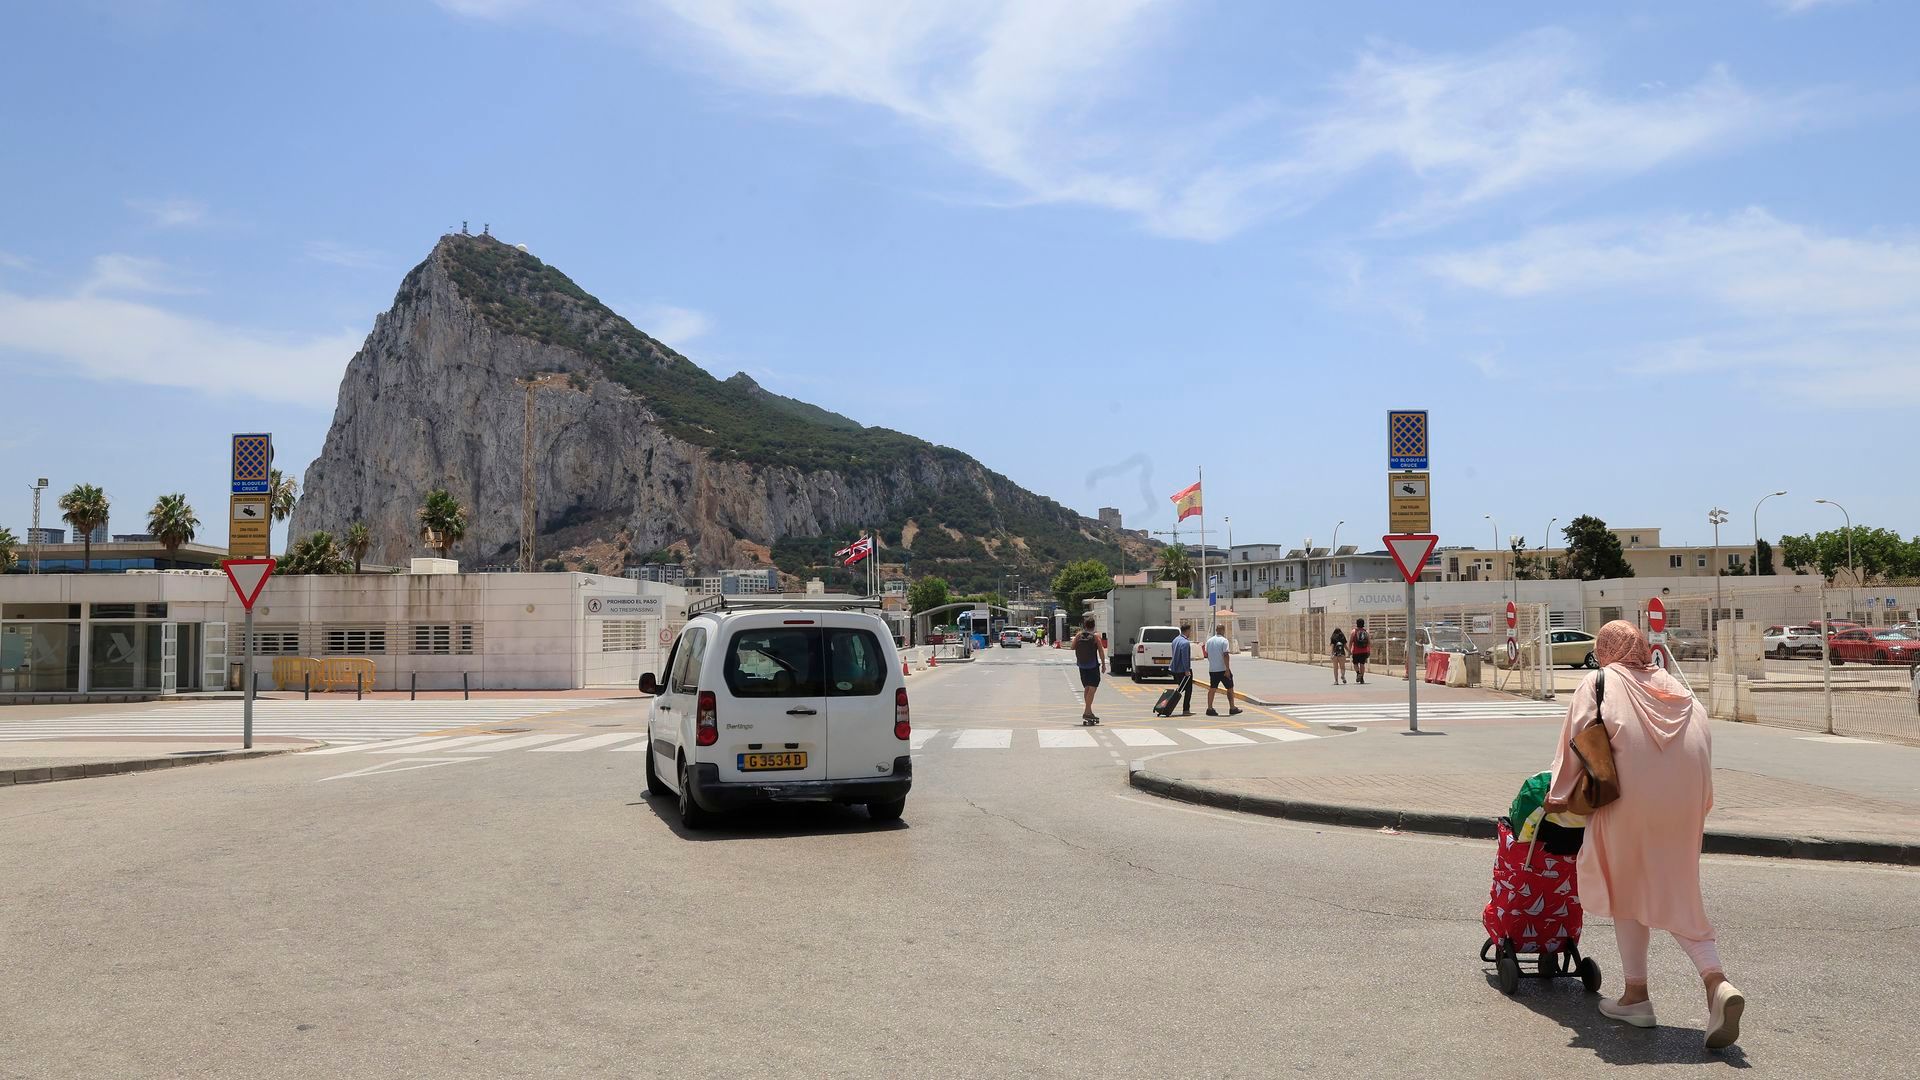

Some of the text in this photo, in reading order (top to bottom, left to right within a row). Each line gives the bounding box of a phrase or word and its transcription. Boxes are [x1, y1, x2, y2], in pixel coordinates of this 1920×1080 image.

[1359, 594, 1403, 603] ADUANA
[749, 754, 802, 767] G 3534 D
